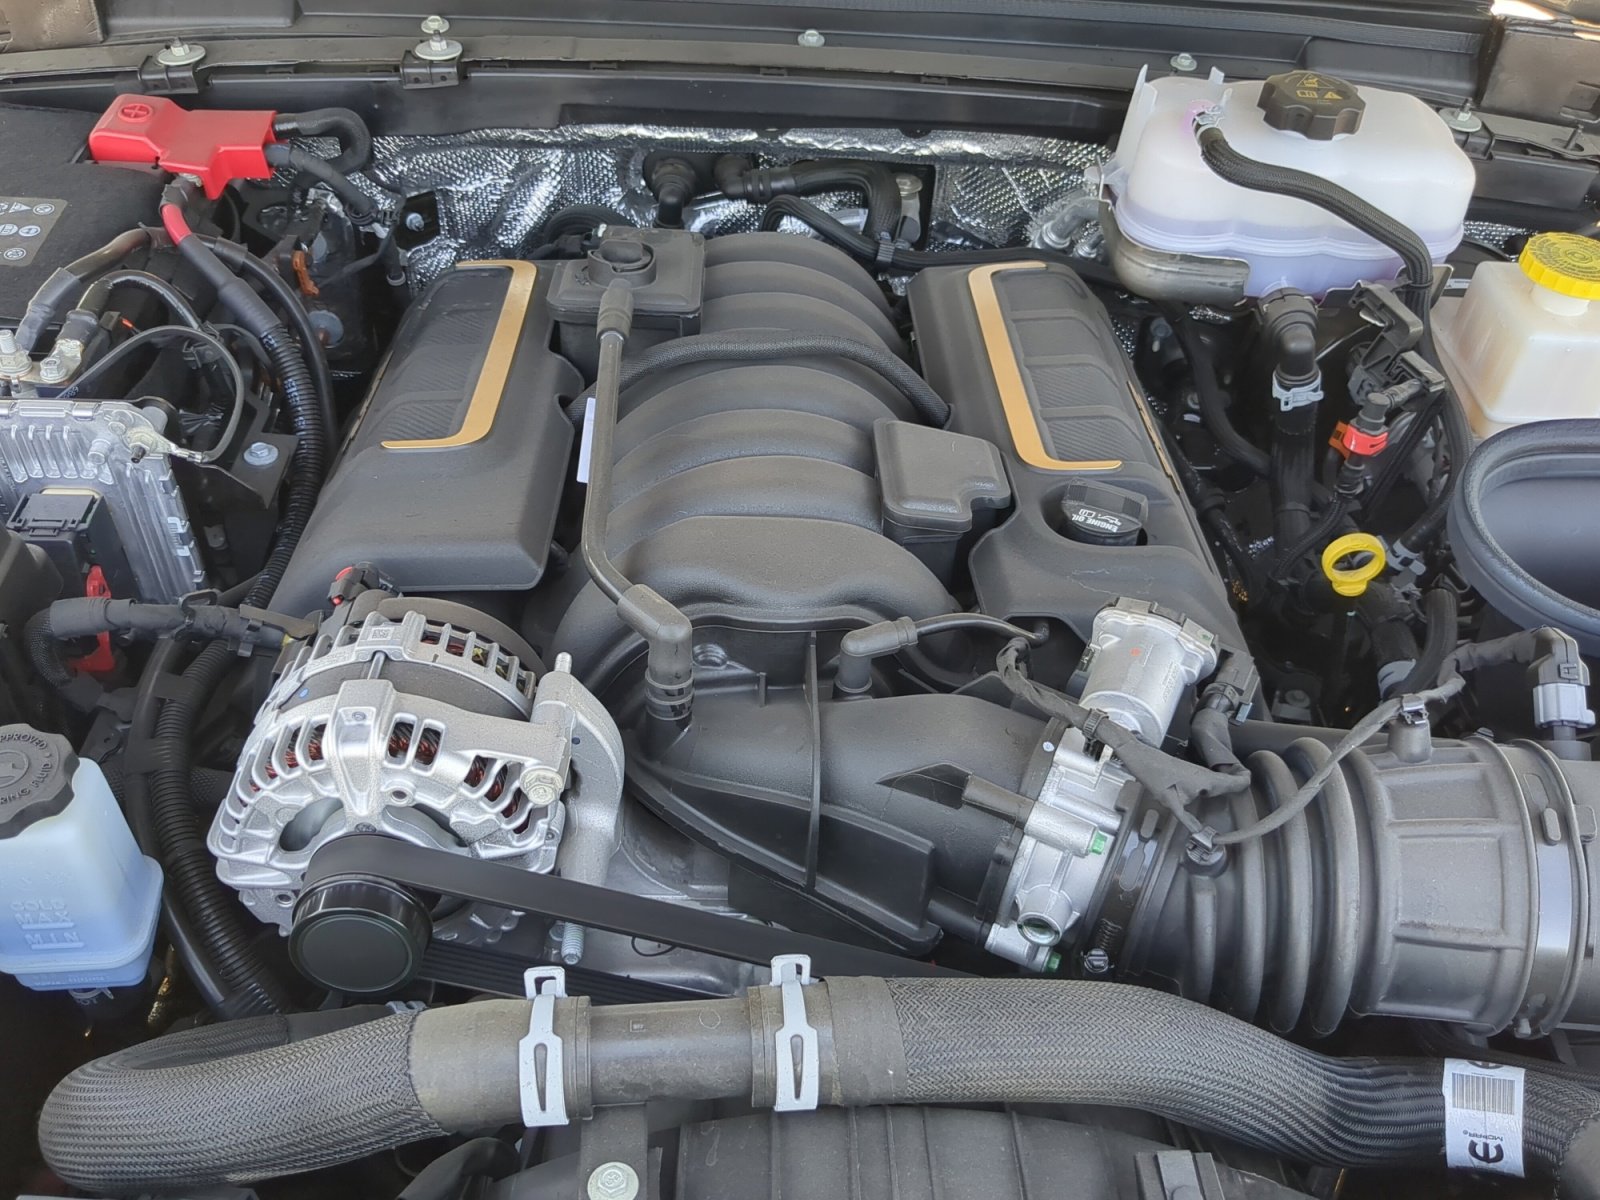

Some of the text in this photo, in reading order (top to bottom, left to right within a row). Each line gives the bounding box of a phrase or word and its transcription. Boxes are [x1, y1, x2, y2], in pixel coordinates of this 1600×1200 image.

[1071, 513, 1118, 532] ENGINE OIL
[15, 911, 72, 925] MAX
[24, 932, 80, 945] MIN
